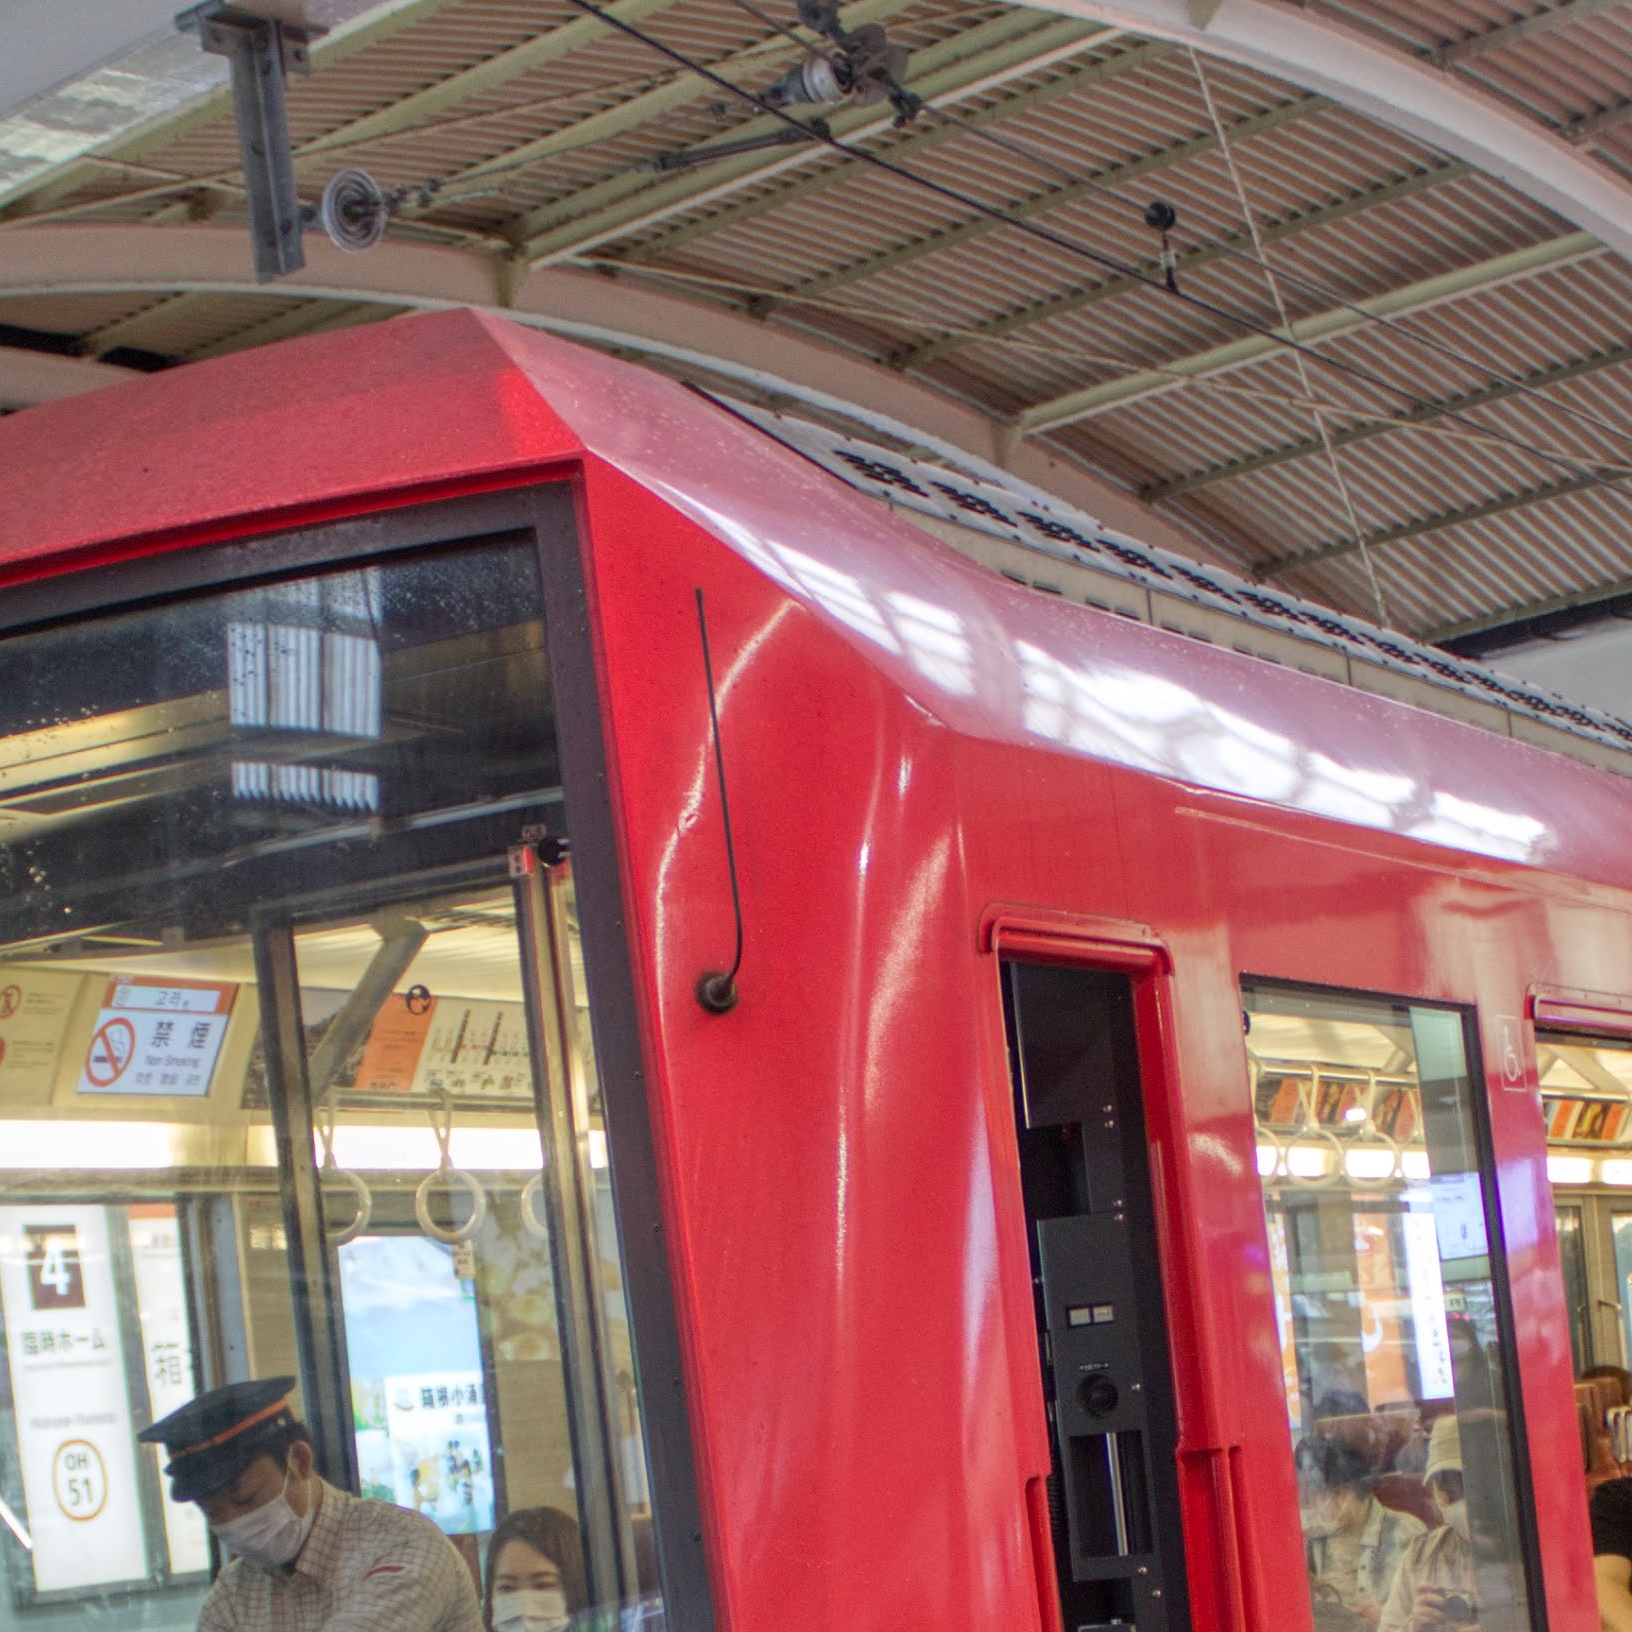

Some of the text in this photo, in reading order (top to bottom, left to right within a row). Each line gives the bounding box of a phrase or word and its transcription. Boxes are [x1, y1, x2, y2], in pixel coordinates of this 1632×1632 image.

[151, 1021, 211, 1049] 禁煙
[40, 1240, 71, 1296] 4
[22, 1328, 107, 1356] 臨時ホーム
[65, 1453, 87, 1471] OH
[68, 1478, 93, 1506] 51
